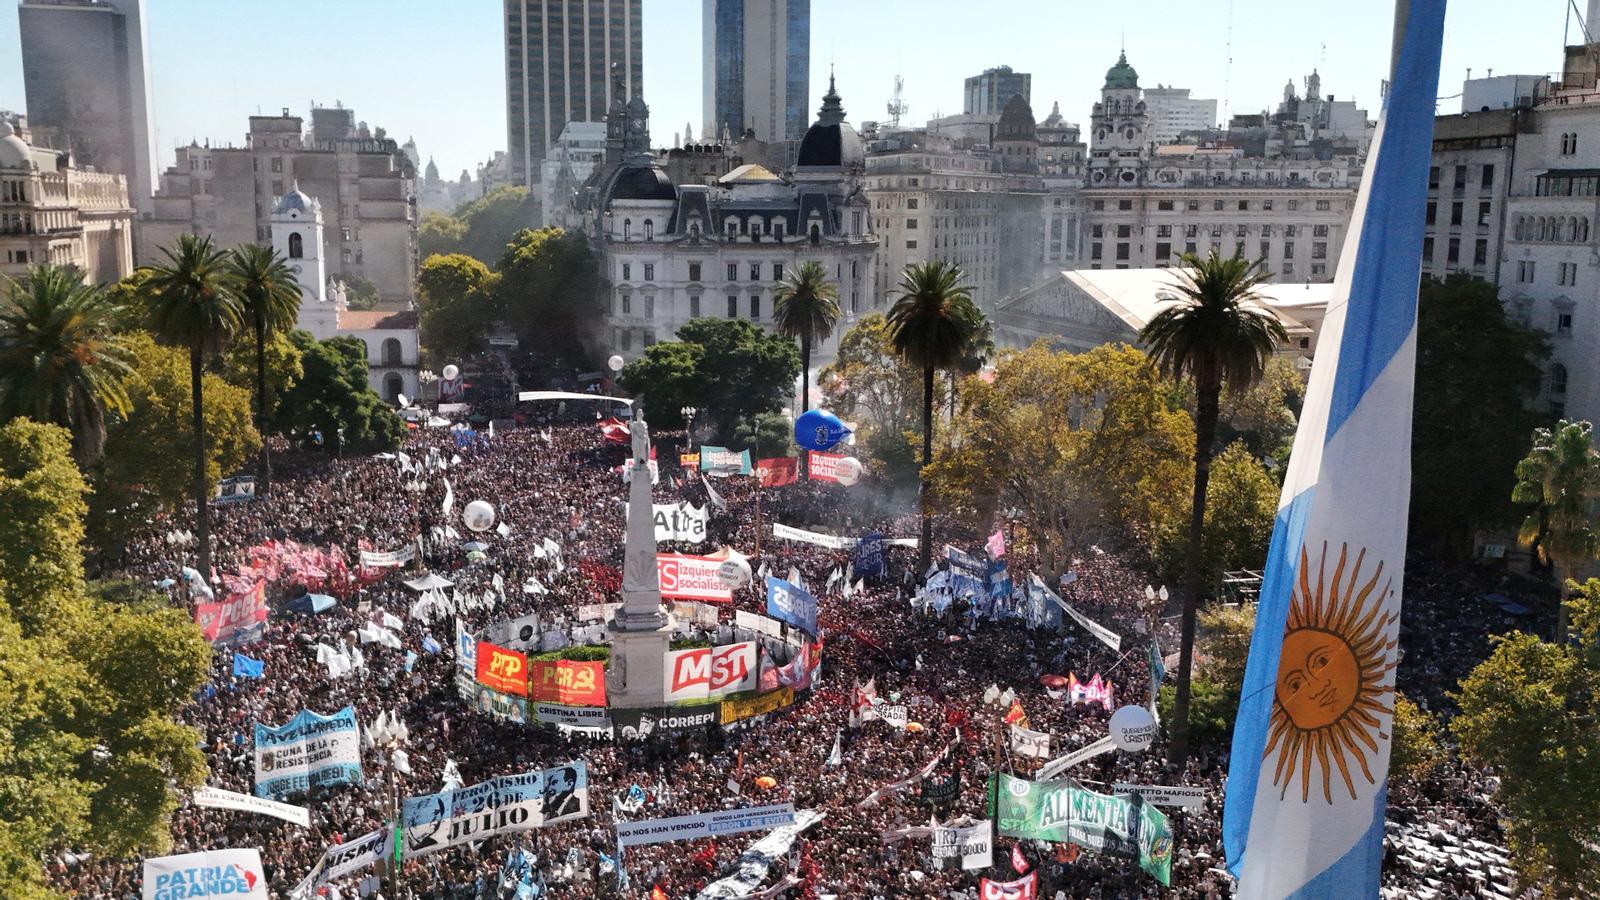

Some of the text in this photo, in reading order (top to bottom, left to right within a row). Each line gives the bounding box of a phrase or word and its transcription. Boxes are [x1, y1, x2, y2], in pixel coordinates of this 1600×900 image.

[490, 651, 521, 677] PTP
[679, 651, 746, 685] MST
[543, 667, 573, 687] PCR
[539, 707, 576, 717] CRISTINA
[659, 712, 715, 728] CORREPI
[878, 709, 906, 721] OSADAS
[276, 739, 328, 759] CUNA DE LA
[276, 749, 333, 769] RESISTENCIA
[452, 774, 537, 803] PERONISMO
[503, 791, 524, 806] DE
[1164, 789, 1203, 797] MAFIOSO
[447, 807, 529, 841] JULIO
[619, 821, 705, 838] NO NOS HAN VENCIDO
[156, 863, 239, 890] PATRIA
[154, 878, 250, 900] GRANDE
